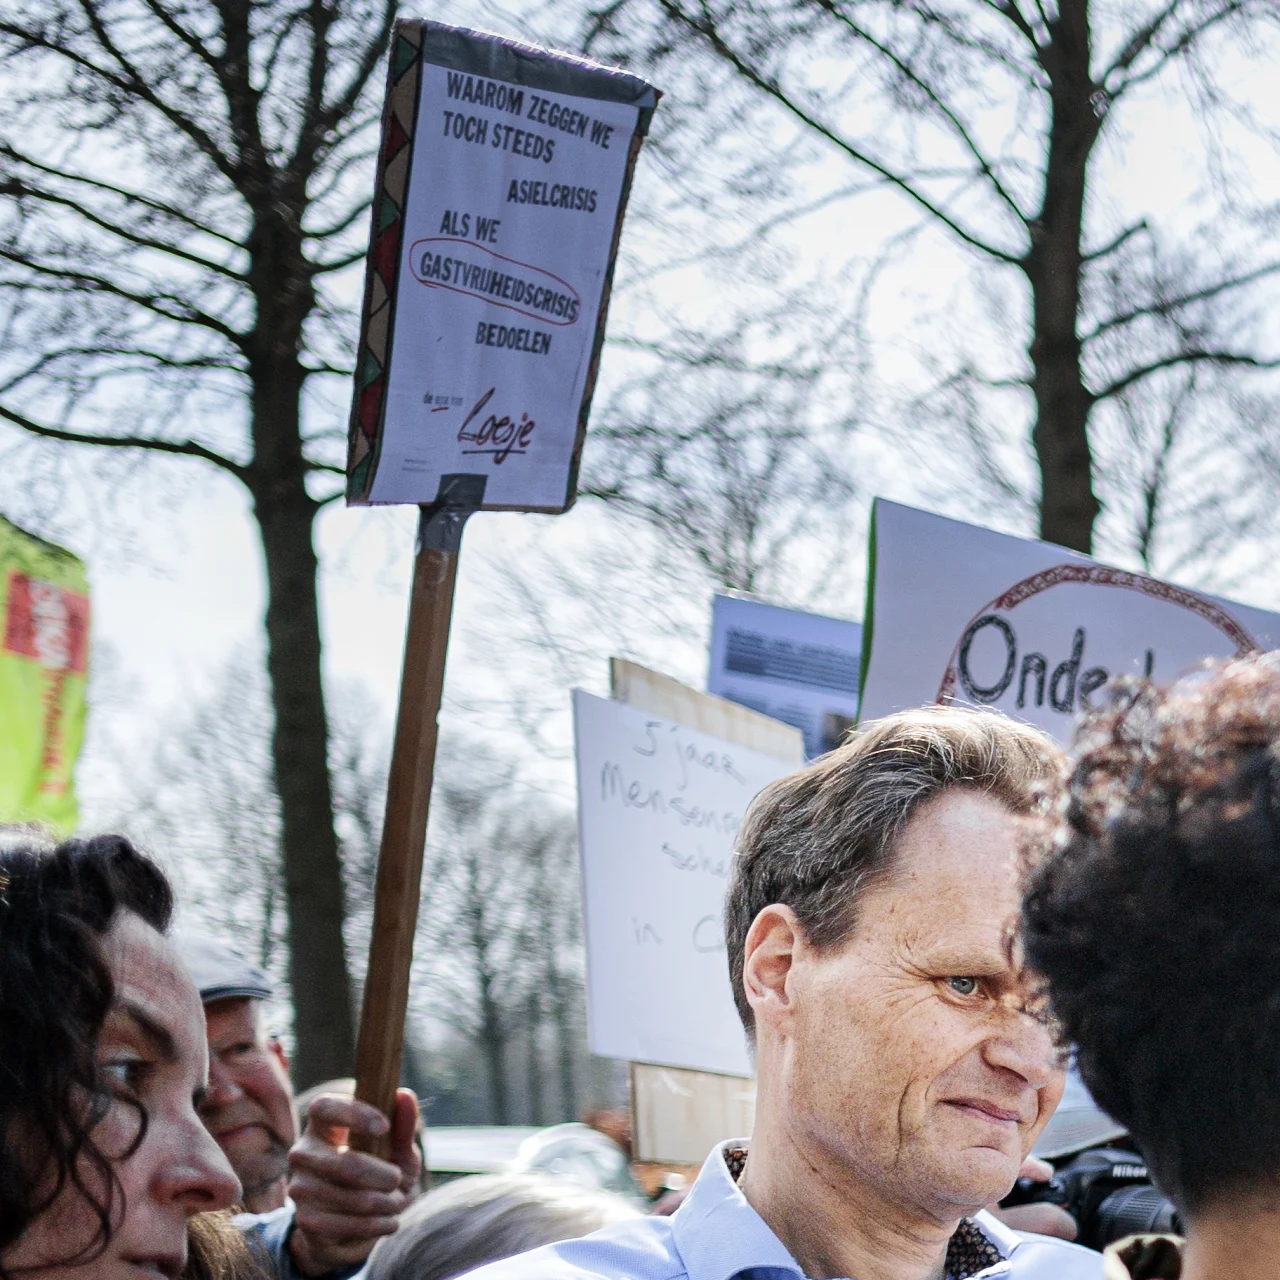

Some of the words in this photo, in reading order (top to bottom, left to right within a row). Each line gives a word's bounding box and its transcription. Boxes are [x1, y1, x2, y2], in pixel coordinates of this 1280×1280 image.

[447, 71, 525, 116] WAAROM
[527, 95, 589, 138] ZEGGEN
[590, 119, 615, 149] WE
[443, 111, 488, 144] TOCH
[492, 123, 555, 163] STEEDS
[507, 179, 597, 213] ASIELCRISIS
[440, 210, 470, 237] ALS
[475, 216, 501, 243] WE
[420, 252, 580, 321] GASTVRIJHEIDSCRISIS
[475, 322, 552, 355] BEDOELEN
[457, 387, 535, 464] Loesje
